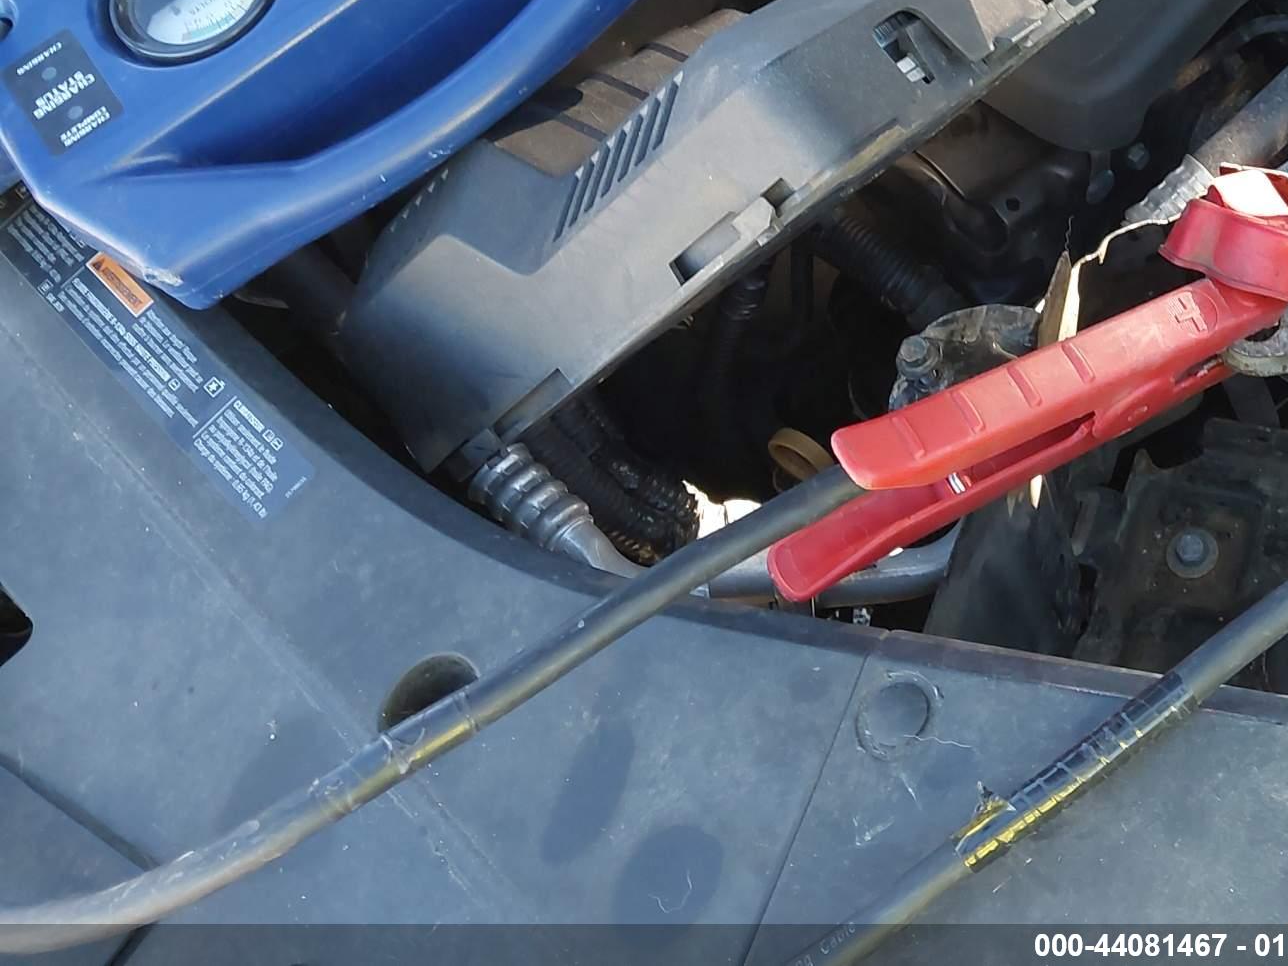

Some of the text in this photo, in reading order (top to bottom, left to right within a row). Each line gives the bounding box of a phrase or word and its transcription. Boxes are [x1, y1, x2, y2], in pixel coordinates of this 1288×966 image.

[14, 40, 63, 76] CHARGING
[32, 72, 95, 120] CHARGING
[34, 70, 84, 107] STATUS
[58, 105, 107, 141] COMPLETE
[62, 110, 110, 147] CHARGING
